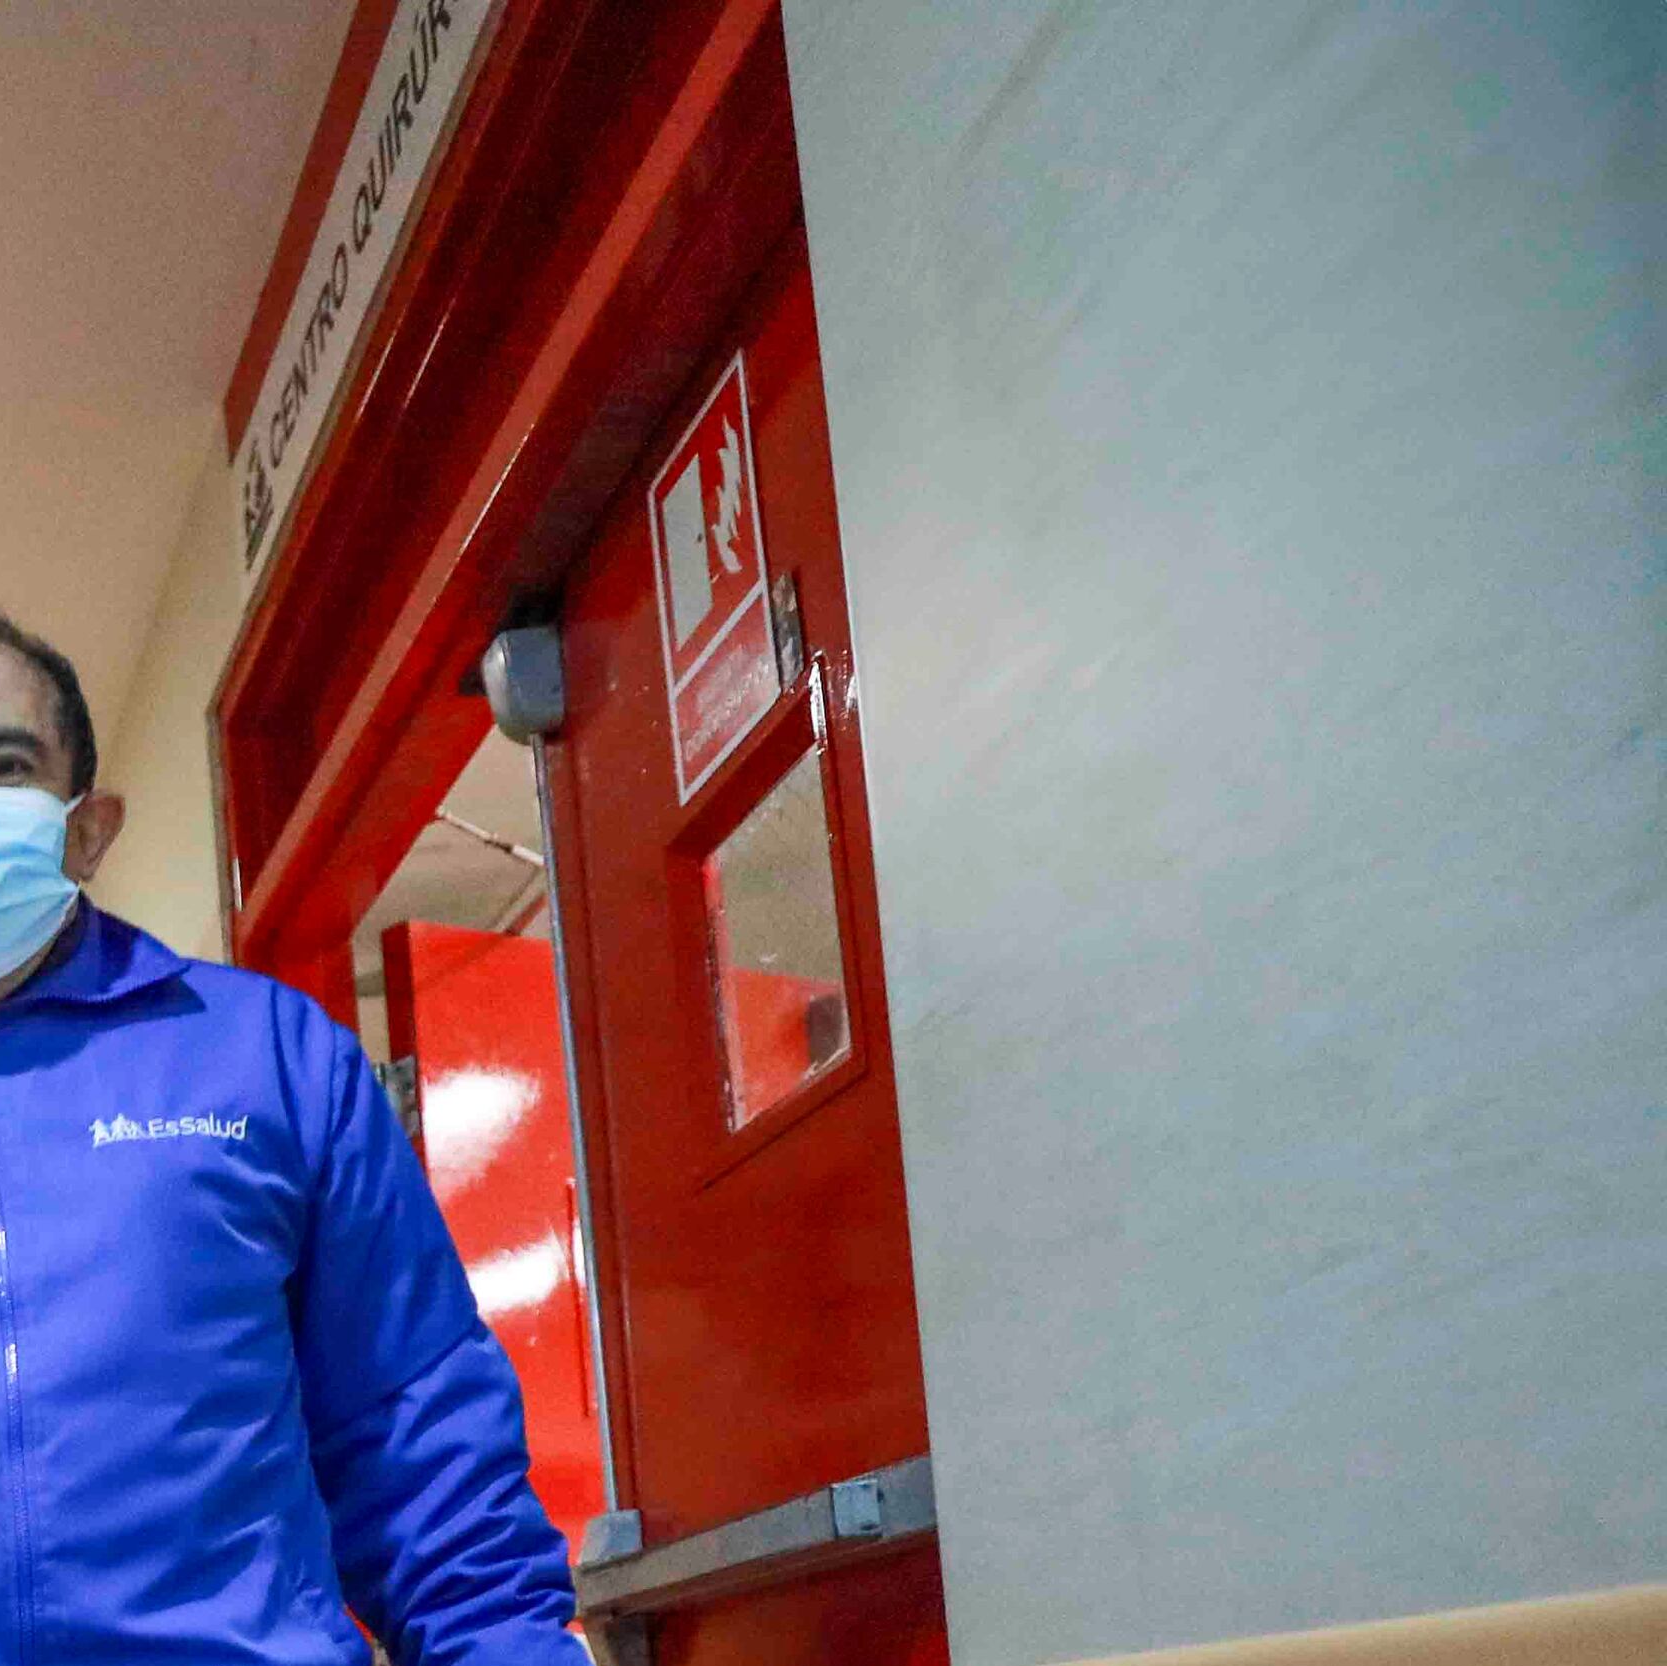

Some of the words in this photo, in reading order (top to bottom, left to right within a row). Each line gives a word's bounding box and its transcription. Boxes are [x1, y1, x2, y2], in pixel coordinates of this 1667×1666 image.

[269, 243, 348, 470] CENTRO
[352, 0, 460, 254] QUIRÚR
[148, 1111, 249, 1141] EsSalud
